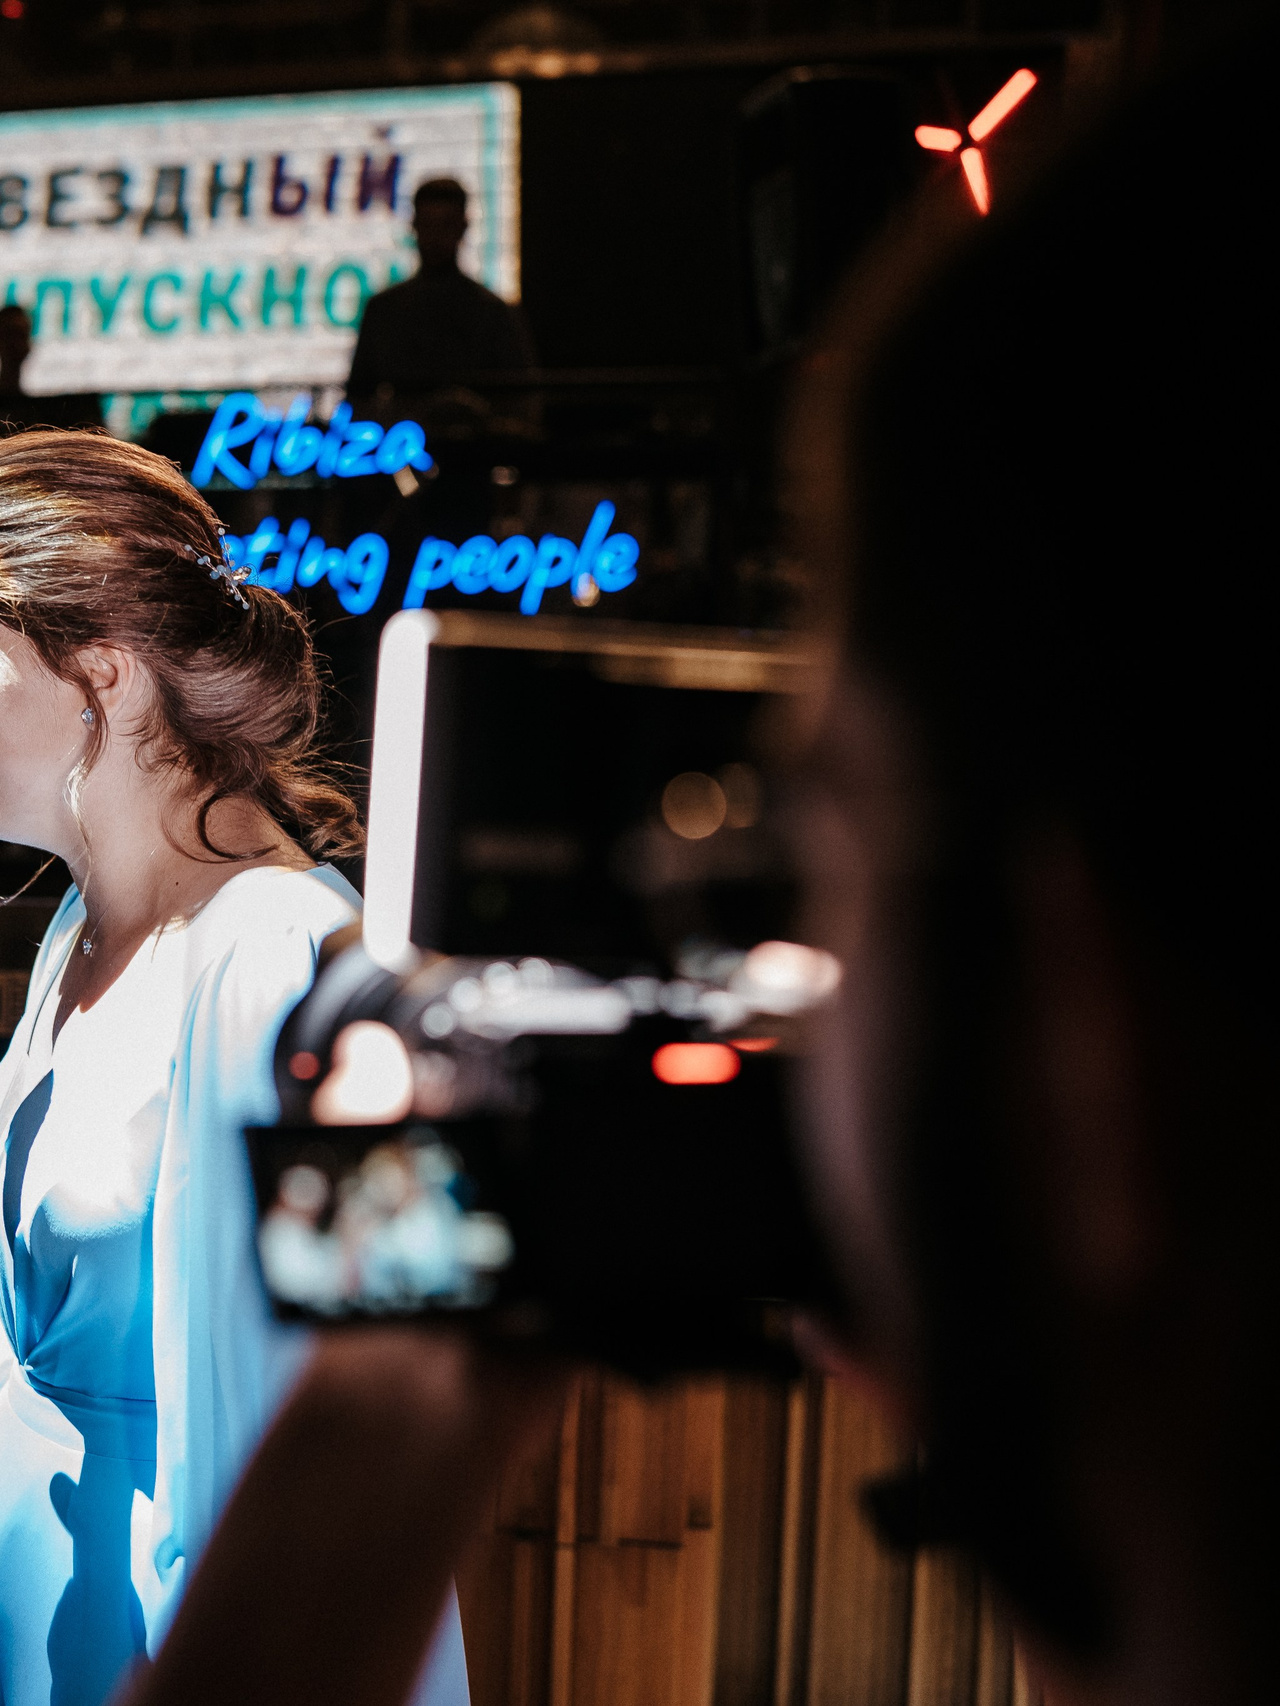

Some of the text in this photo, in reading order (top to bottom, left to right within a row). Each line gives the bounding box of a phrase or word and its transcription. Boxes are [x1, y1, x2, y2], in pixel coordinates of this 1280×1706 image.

[191, 392, 433, 490] Ribiza
[220, 500, 639, 615] ting people
